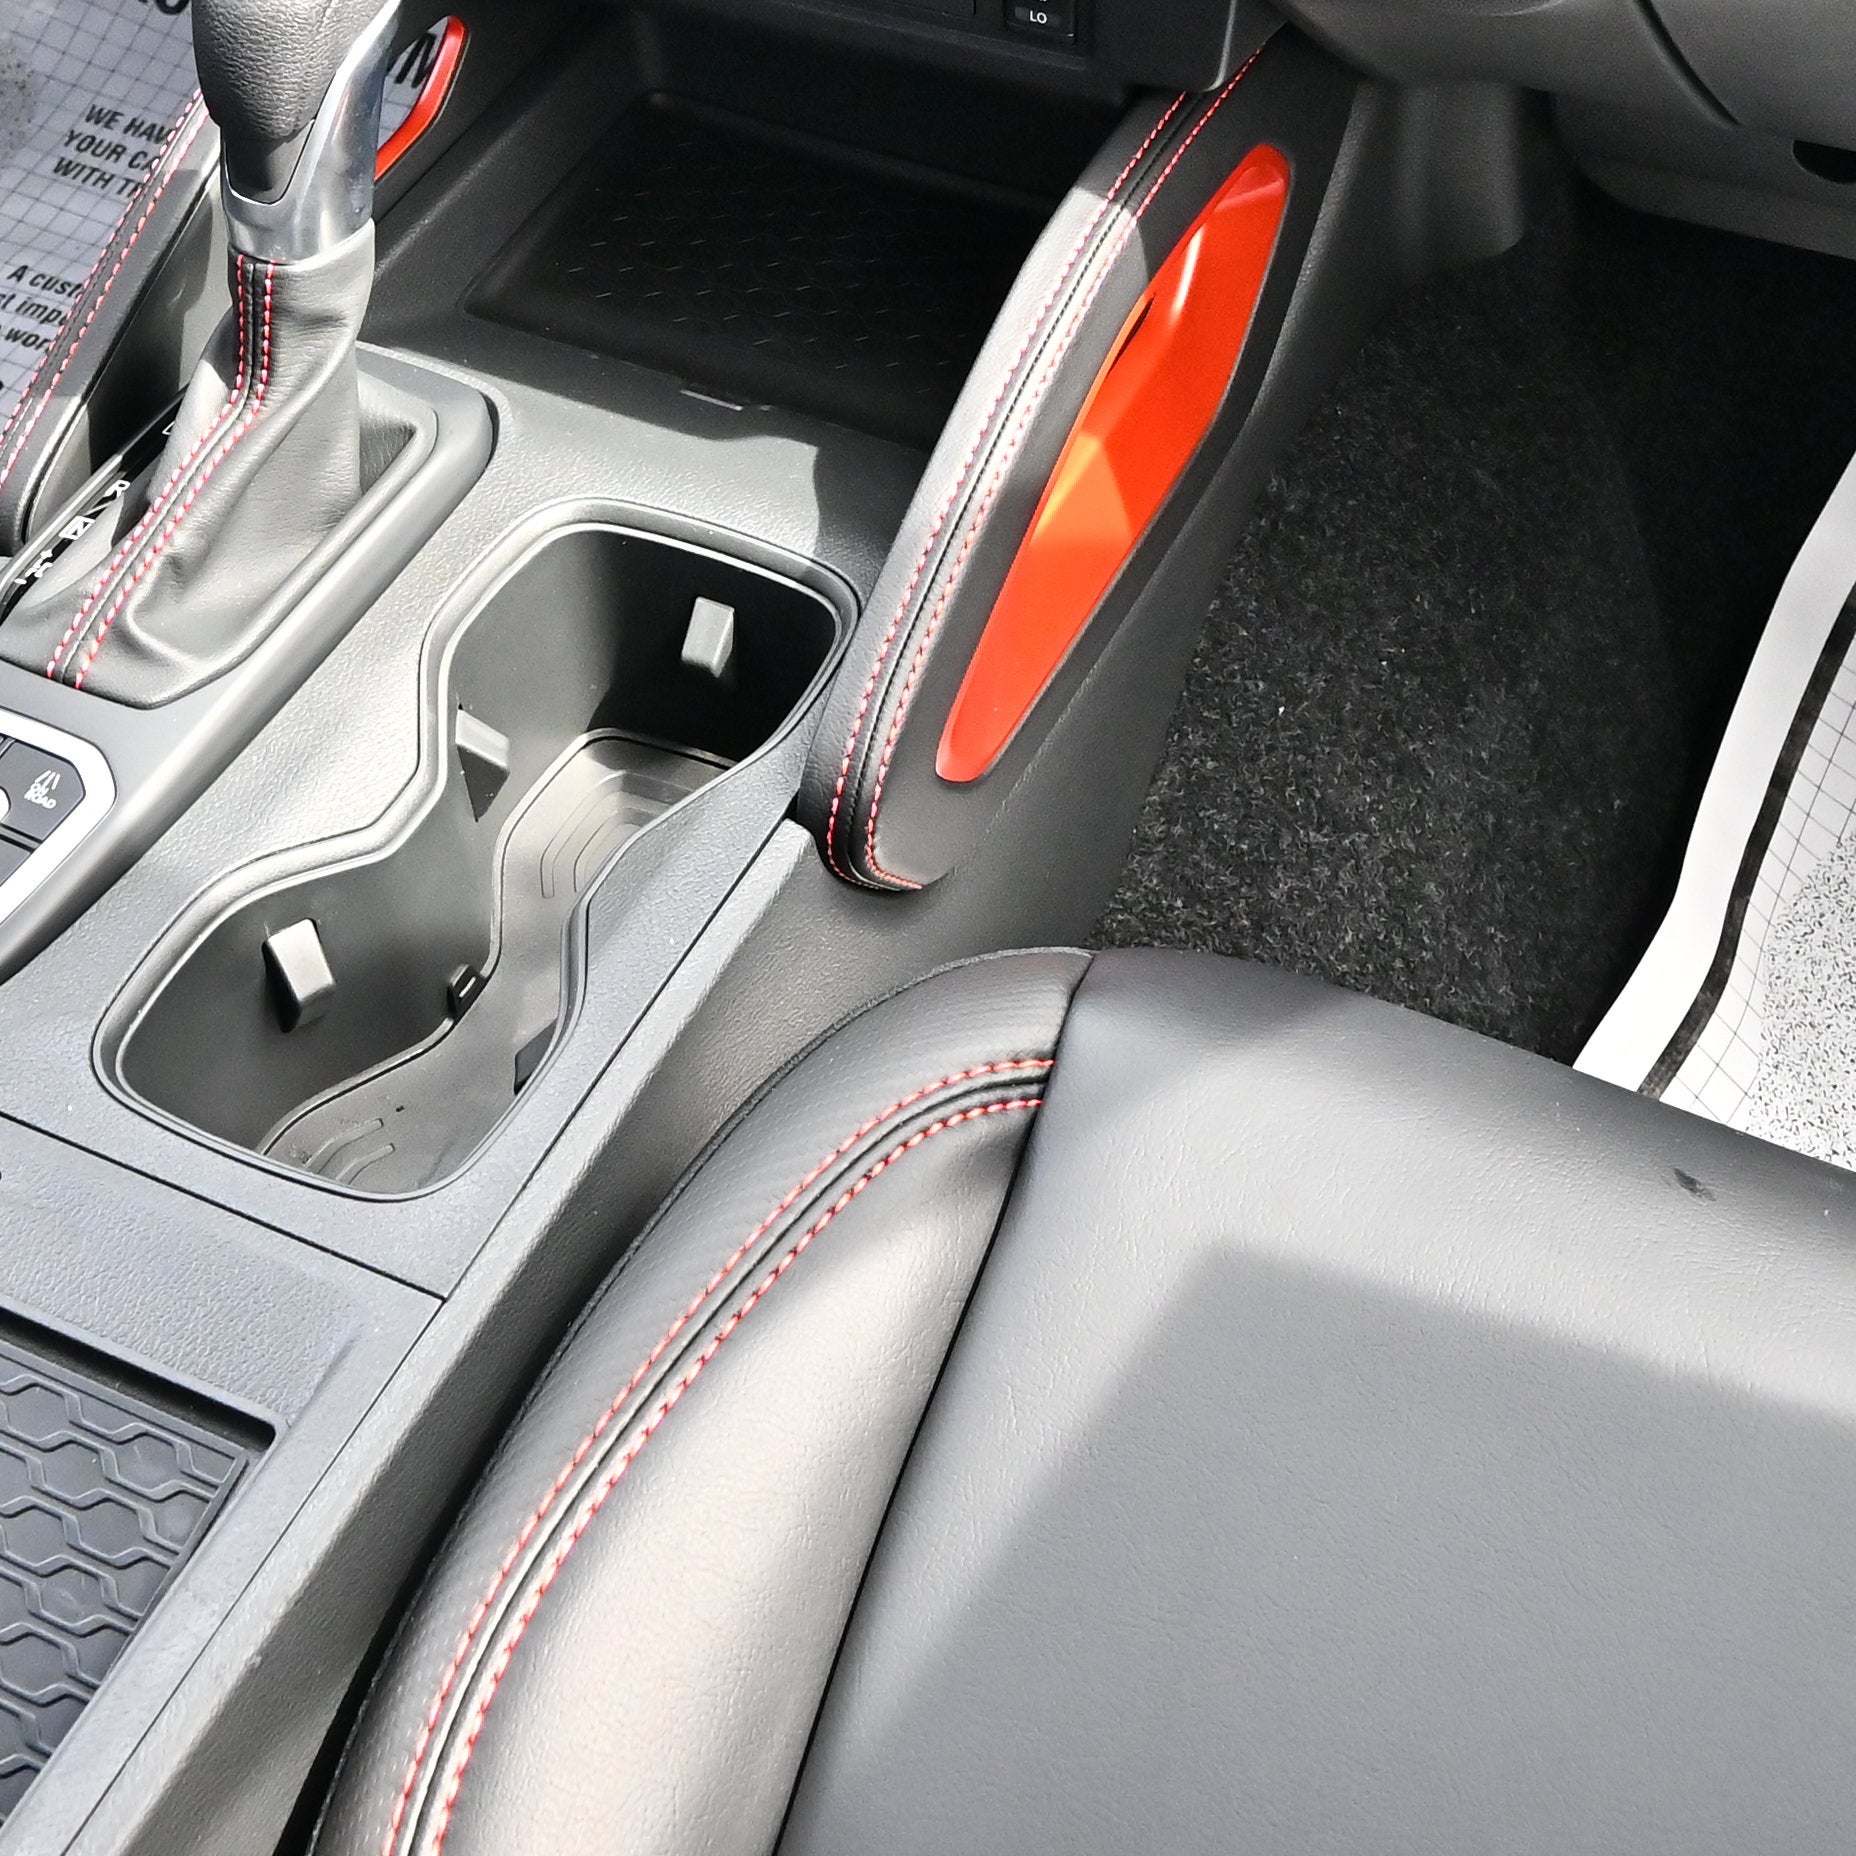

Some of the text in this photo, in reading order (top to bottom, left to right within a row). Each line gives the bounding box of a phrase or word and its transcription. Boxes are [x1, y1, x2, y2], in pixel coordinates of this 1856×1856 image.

[1029, 10, 1047, 24] LO
[85, 104, 123, 130] WE
[65, 130, 127, 163] YOUR
[54, 157, 114, 190] WITH
[7, 264, 29, 282] A
[24, 789, 57, 811] ROAD
